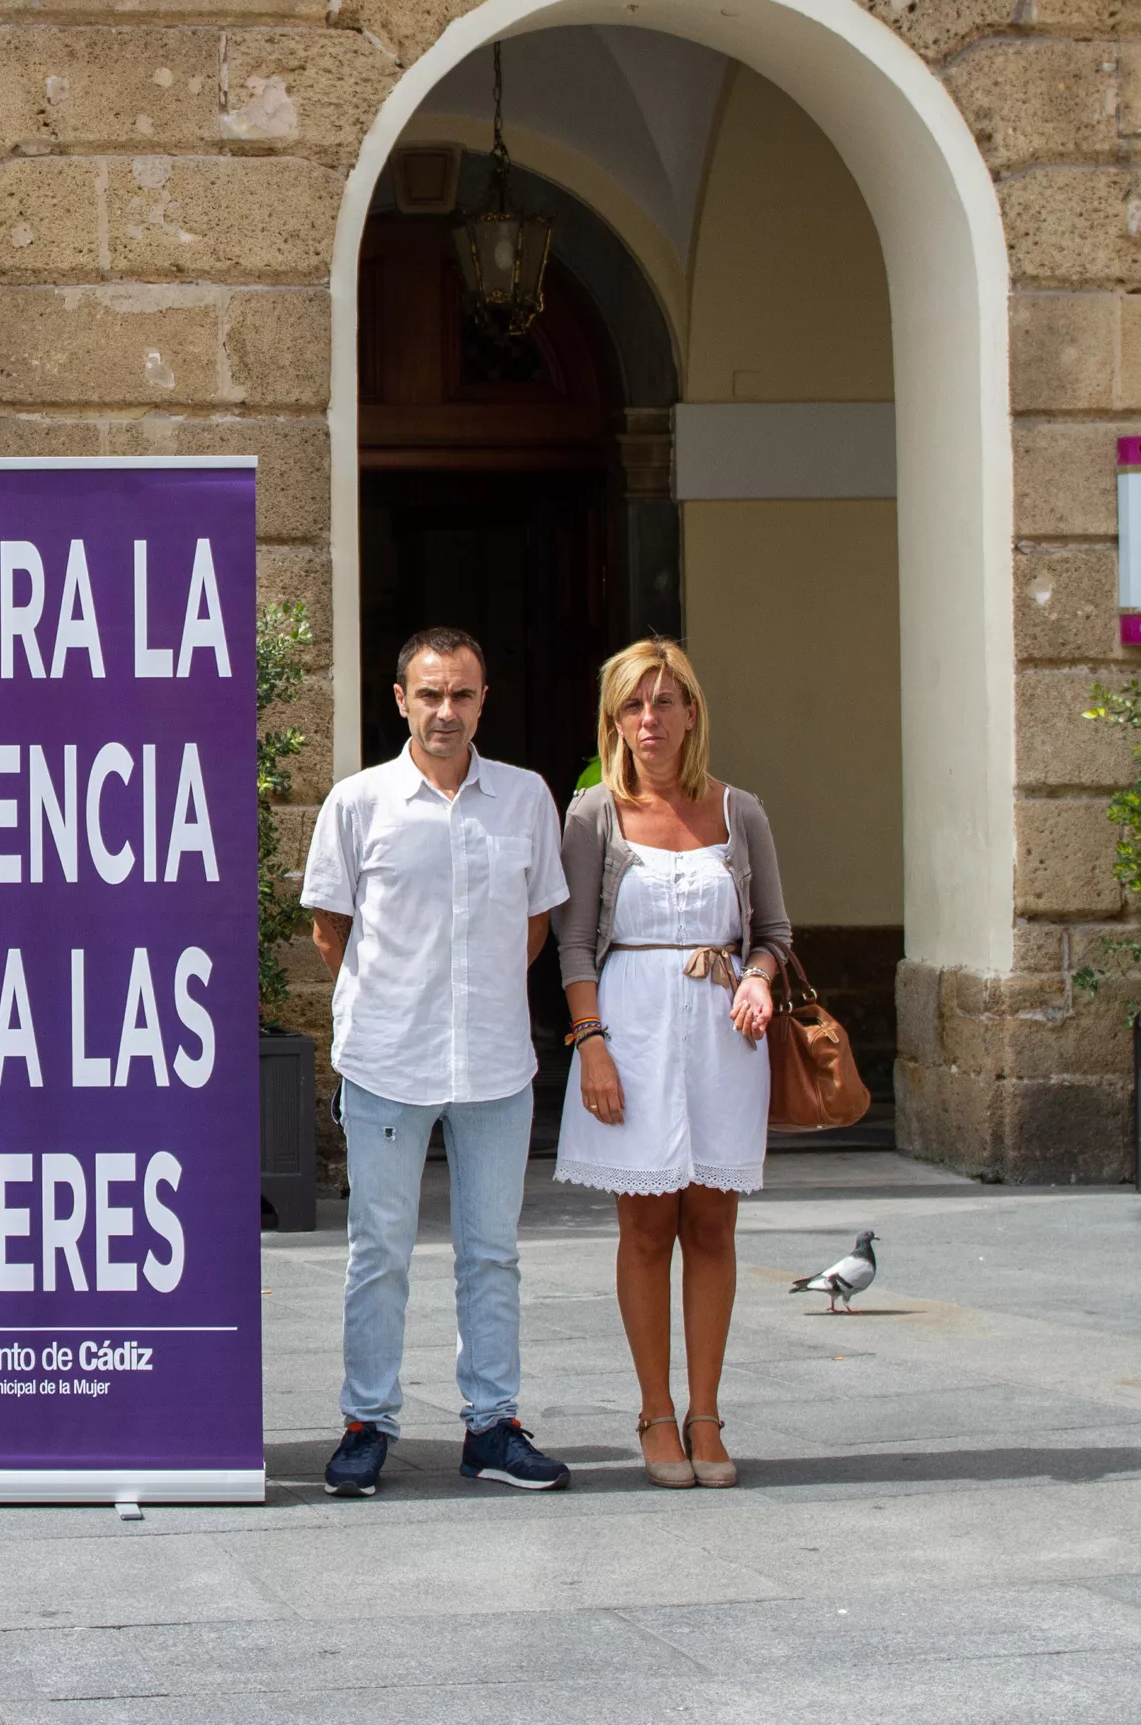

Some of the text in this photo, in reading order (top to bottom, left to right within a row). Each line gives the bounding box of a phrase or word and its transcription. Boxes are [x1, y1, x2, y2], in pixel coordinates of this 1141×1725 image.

[134, 539, 233, 678] LA
[72, 946, 216, 1089] LAS
[39, 1379, 57, 1395] de
[59, 1379, 71, 1395] la
[73, 1379, 111, 1398] Mujer
[41, 1341, 73, 1371] de
[78, 1340, 153, 1371] Cádiz
